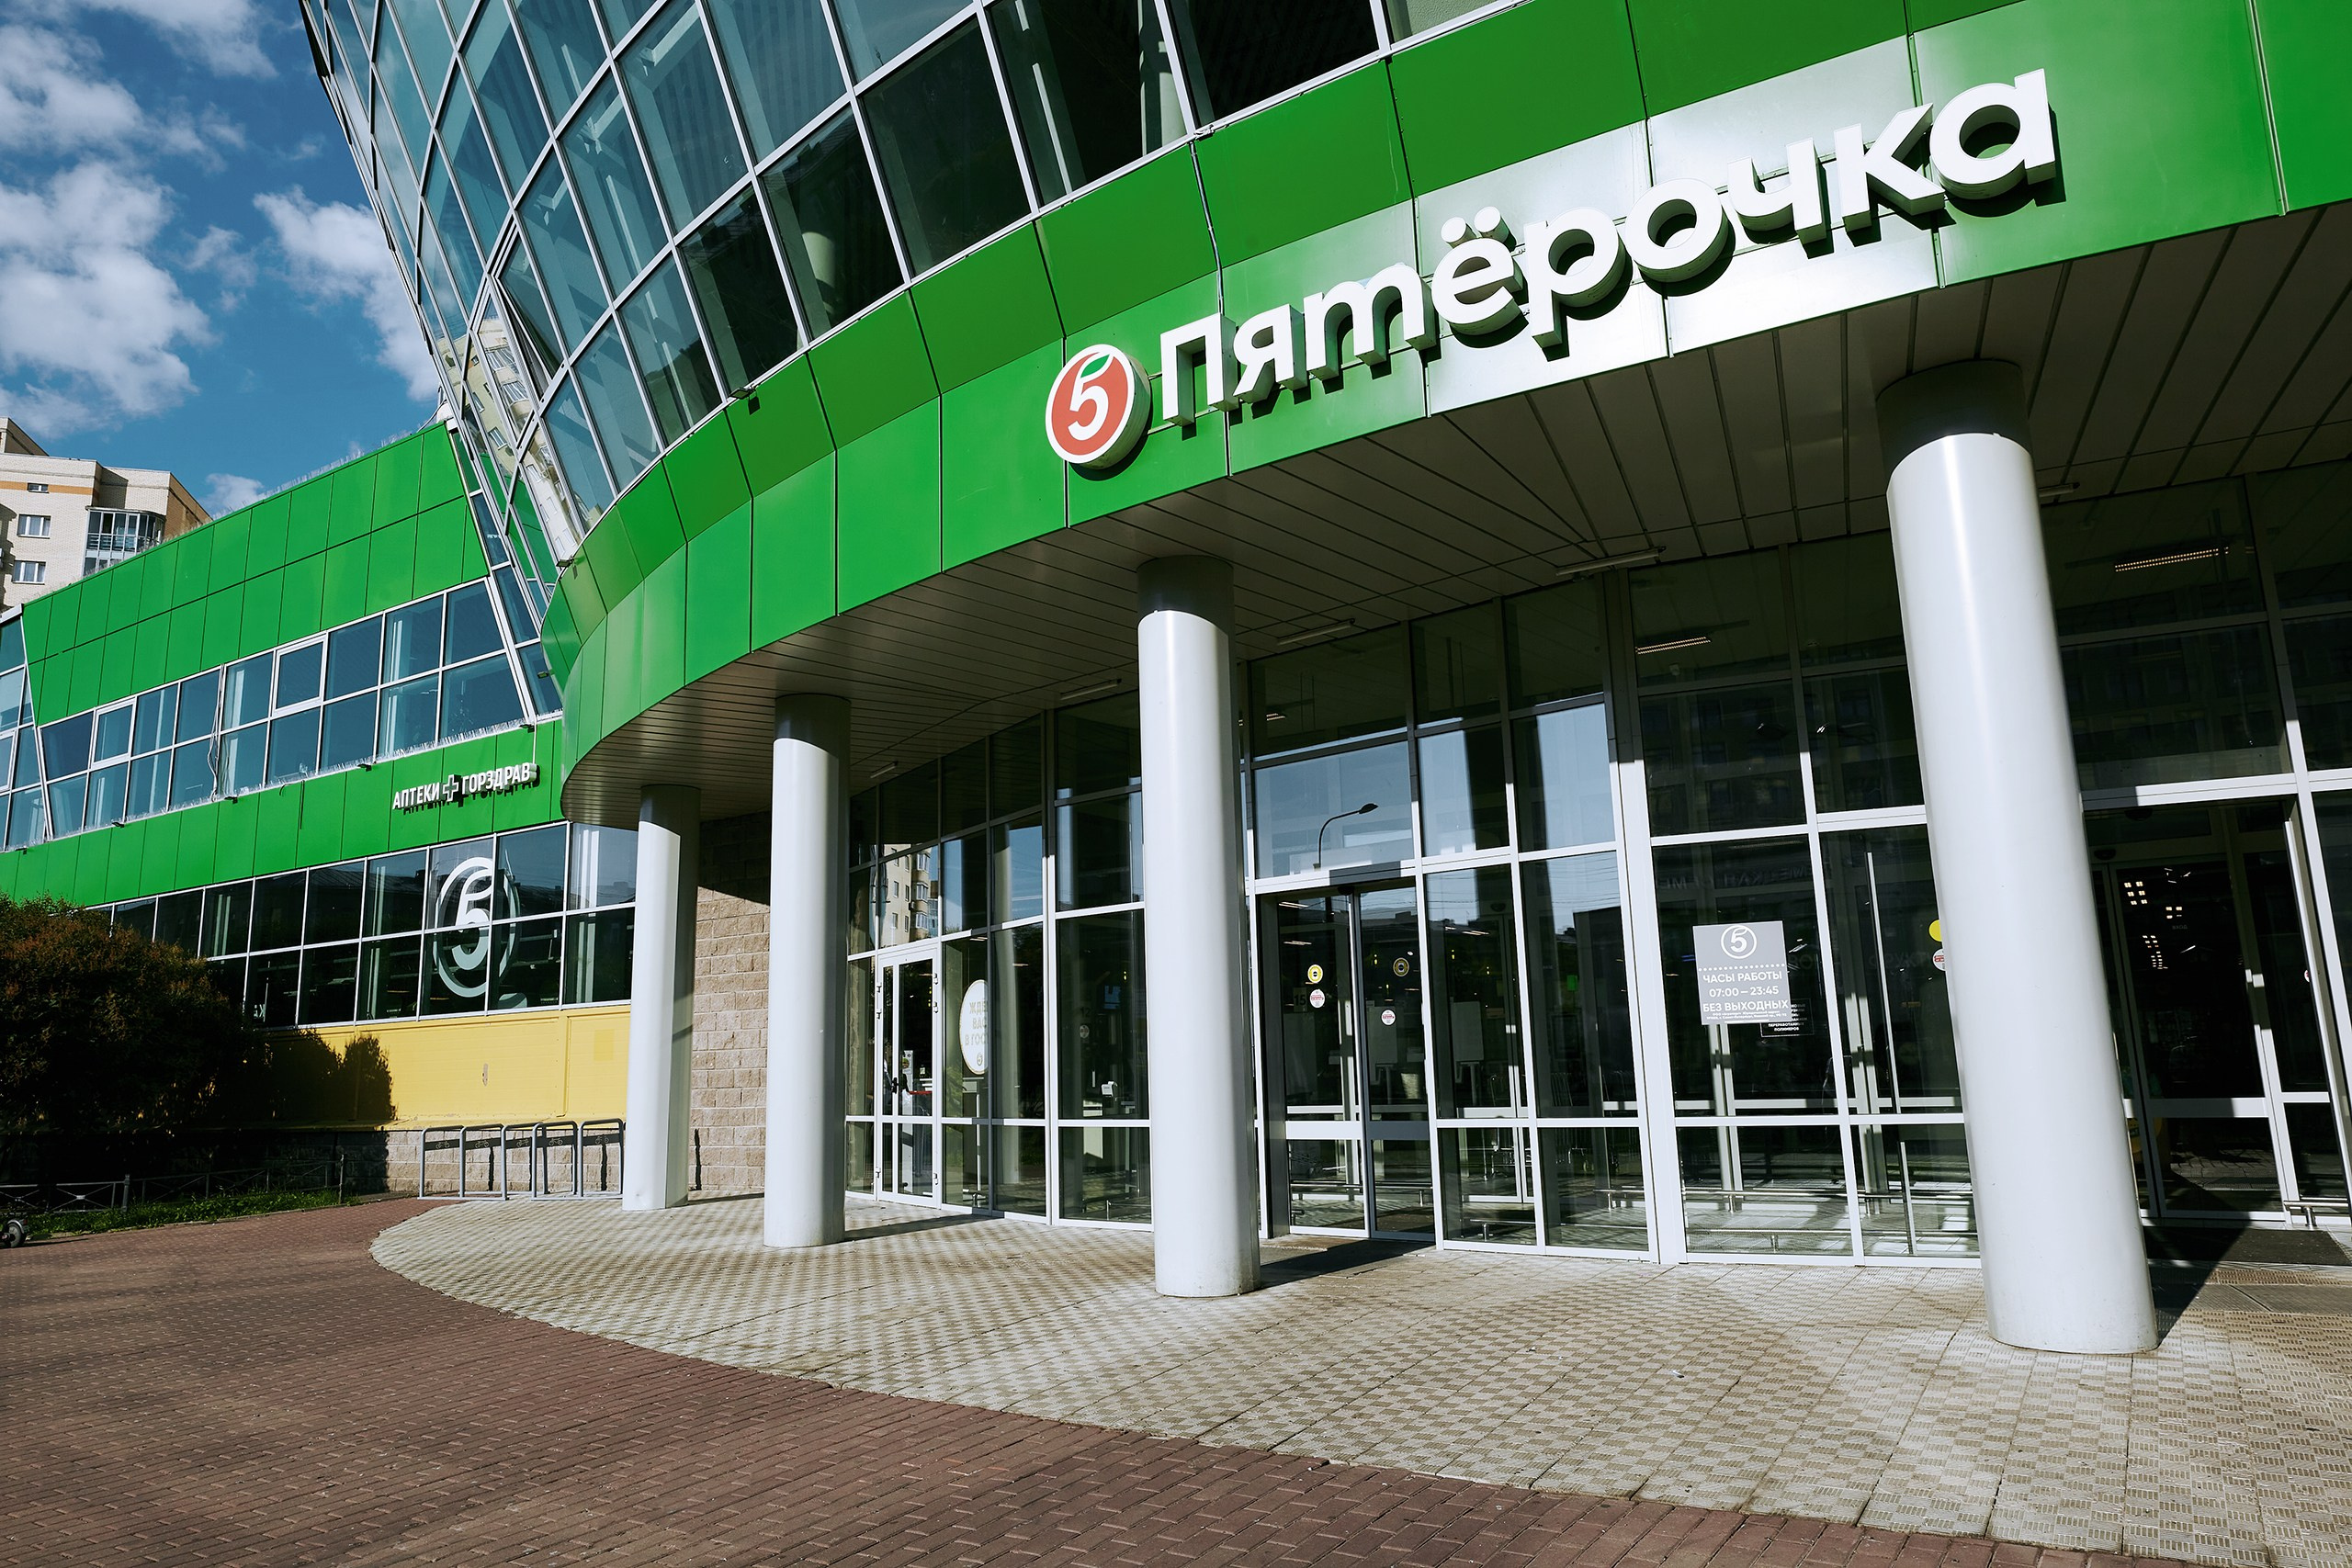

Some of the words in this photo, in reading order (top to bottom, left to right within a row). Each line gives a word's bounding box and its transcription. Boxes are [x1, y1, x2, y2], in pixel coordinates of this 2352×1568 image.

[1160, 68, 2055, 428] Пятёрочка
[392, 782, 440, 809] АПТЕКИ
[461, 761, 532, 795] ГОРЗДРАВ
[1702, 973, 1736, 984] ЧАСЫ
[1737, 971, 1782, 982] РАБОТЫ
[1709, 987, 1739, 998] 07:00
[1750, 986, 1780, 996] 23:45
[969, 998, 989, 1015] ЖДЁ
[1294, 994, 1306, 1006] 15
[1702, 1002, 1723, 1012] БЕЗ
[1724, 999, 1789, 1011] ВЫХОДНЫХ
[971, 1032, 989, 1046] ГОС
